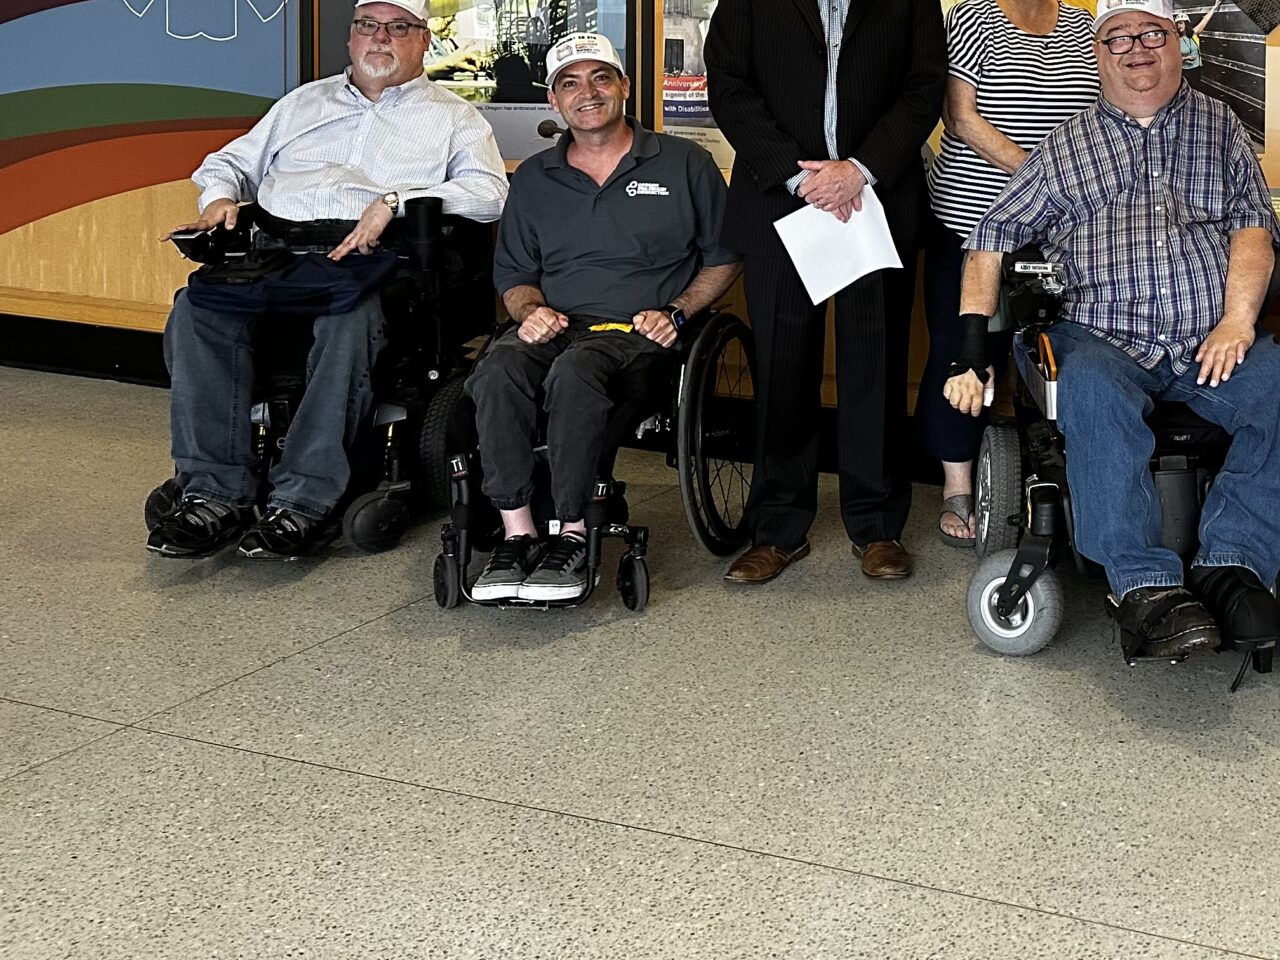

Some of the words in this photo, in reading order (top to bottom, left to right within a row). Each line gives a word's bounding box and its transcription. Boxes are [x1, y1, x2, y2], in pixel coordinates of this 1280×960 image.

[663, 81, 703, 89] Anniversary
[451, 458, 462, 472] Ti
[597, 483, 606, 495] Ti
